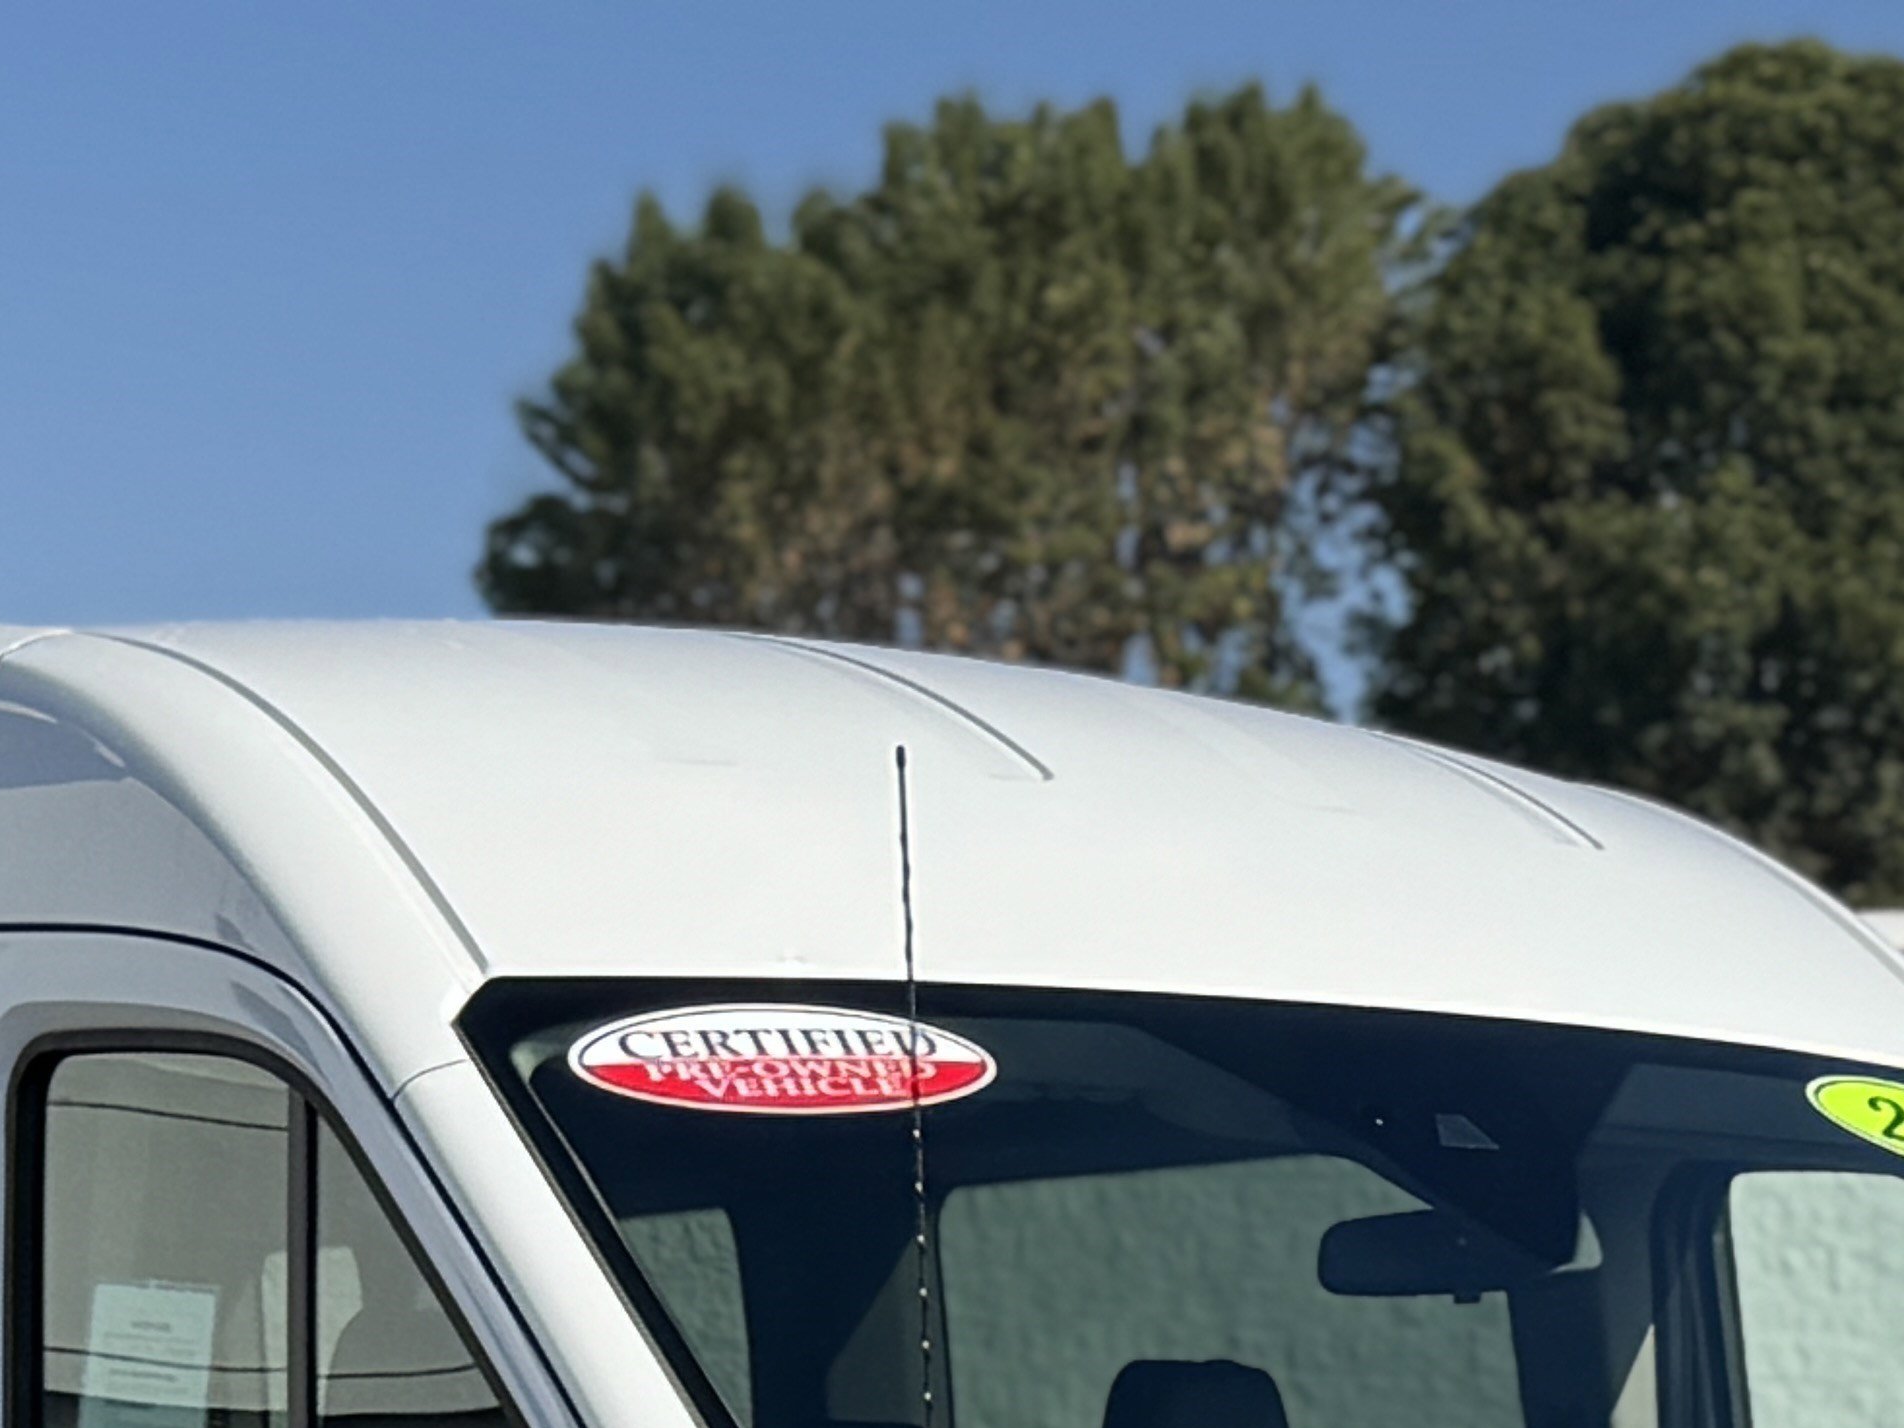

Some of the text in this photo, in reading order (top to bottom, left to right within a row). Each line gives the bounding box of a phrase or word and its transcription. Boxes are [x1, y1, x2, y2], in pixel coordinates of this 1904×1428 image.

[617, 1027, 938, 1060] CERTIFIED
[645, 1056, 938, 1082] PRE-OWNED
[695, 1076, 913, 1098] VEHICLE
